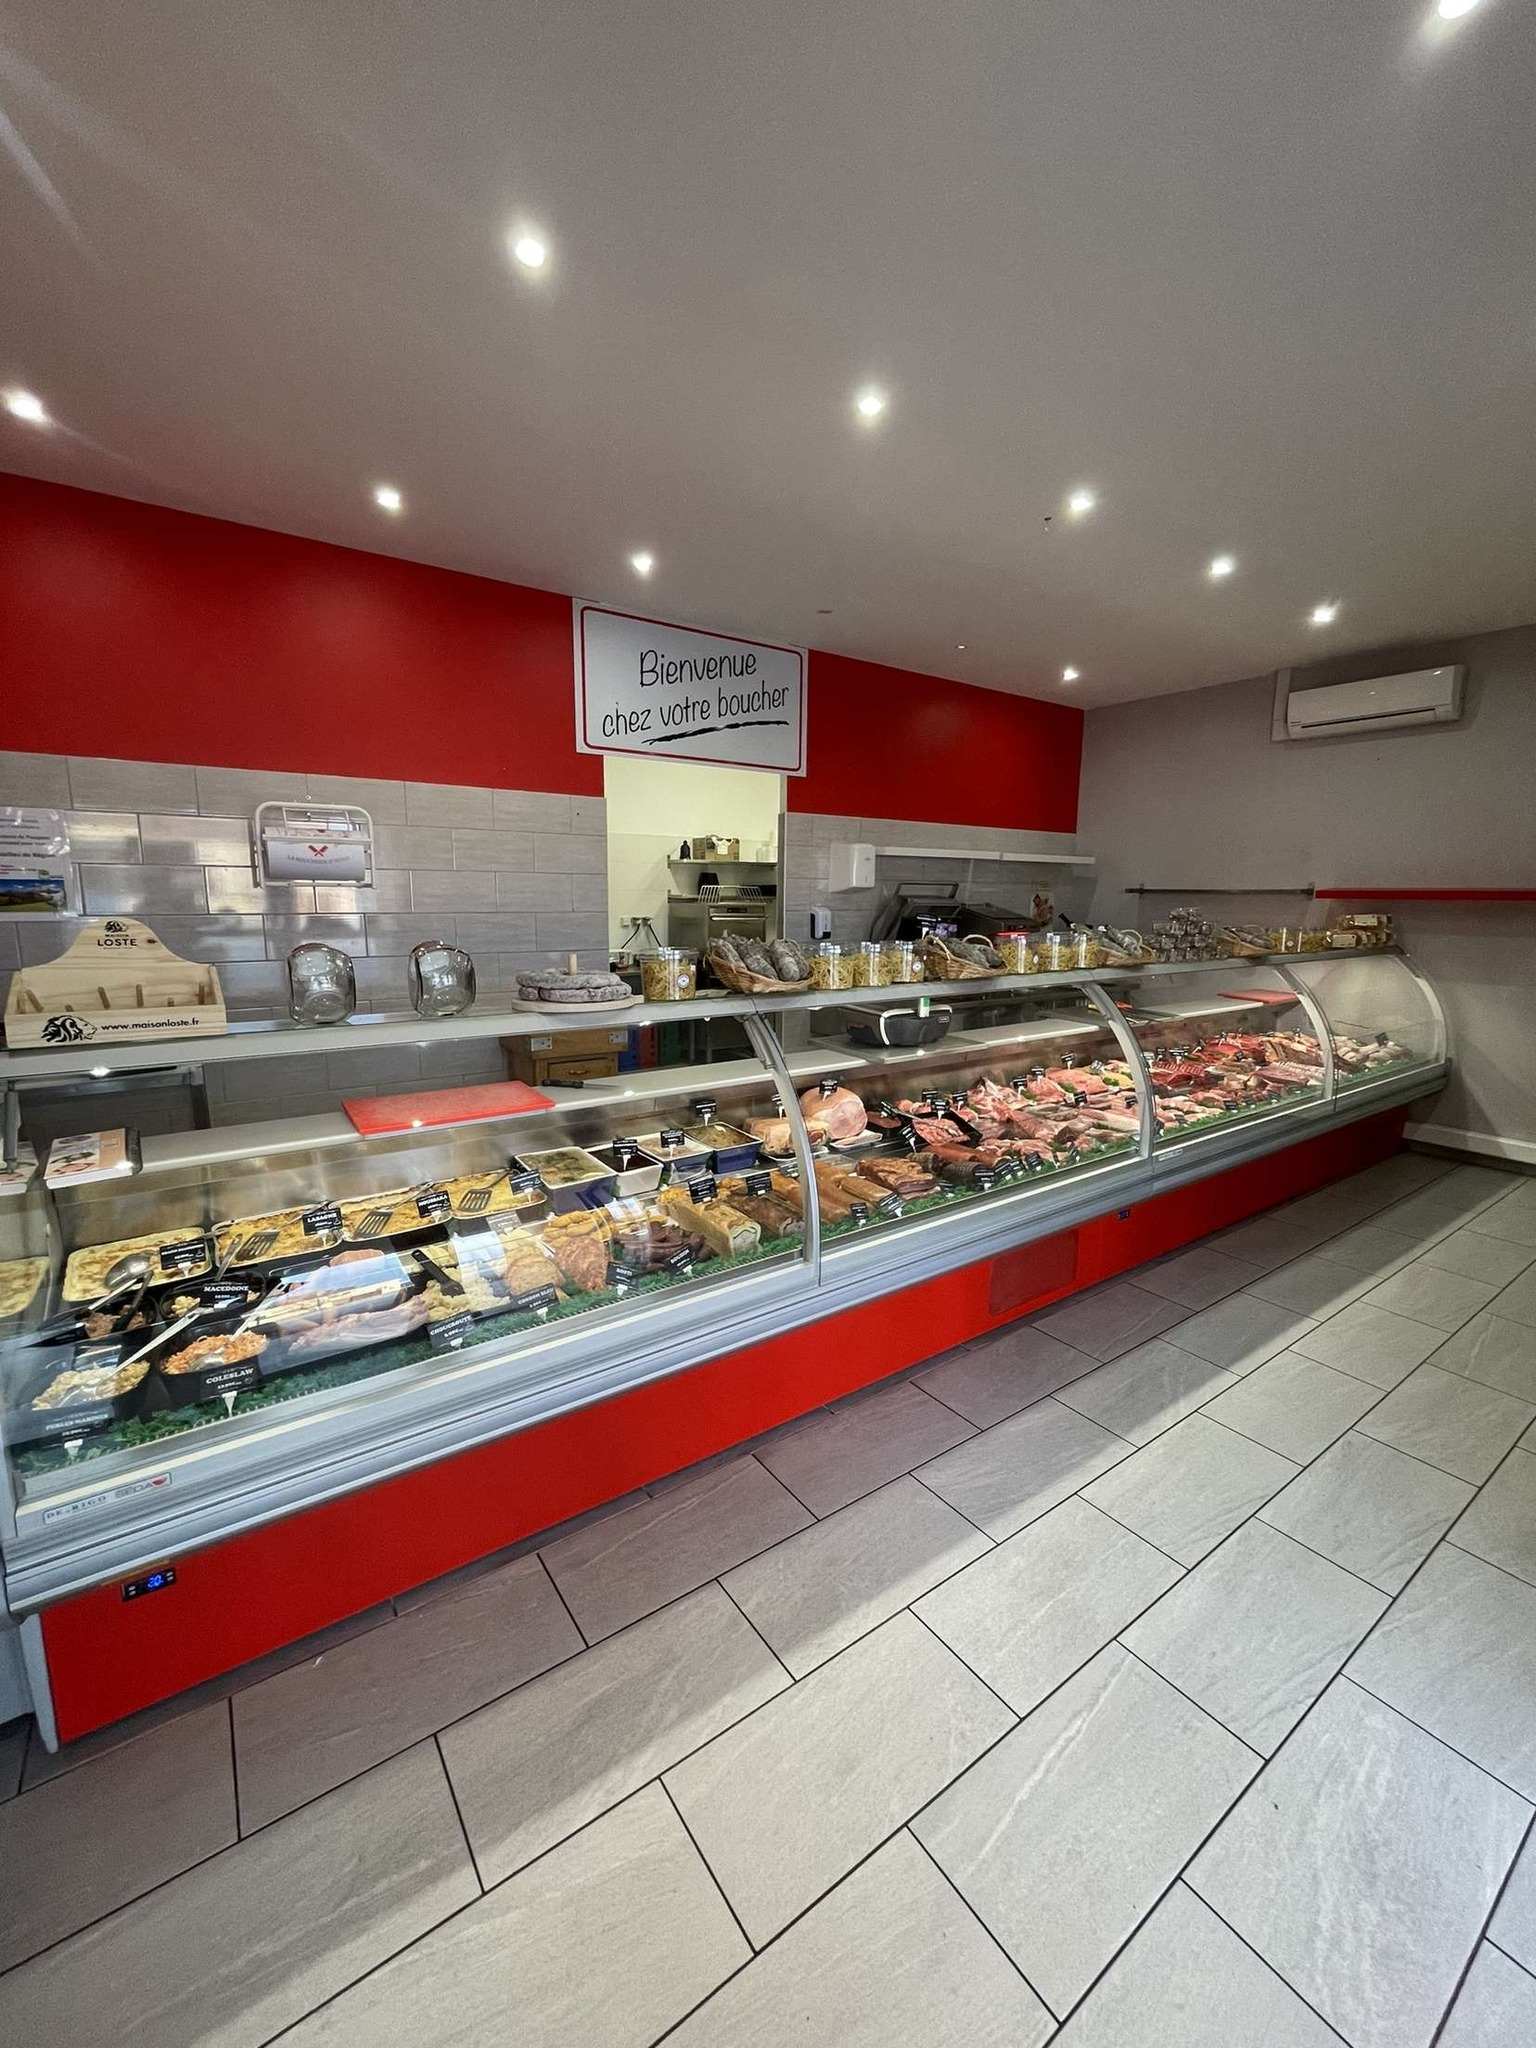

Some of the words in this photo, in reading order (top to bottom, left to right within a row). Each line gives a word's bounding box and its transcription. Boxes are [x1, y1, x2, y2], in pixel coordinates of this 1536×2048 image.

[640, 649, 757, 687] Bienvenue
[602, 701, 651, 737] chez
[660, 696, 711, 726] votre
[718, 680, 789, 717] boucher
[97, 938, 137, 947] LOSTE
[101, 1017, 200, 1031] www.maisonloste.fr
[205, 1367, 254, 1385] COLESLAW
